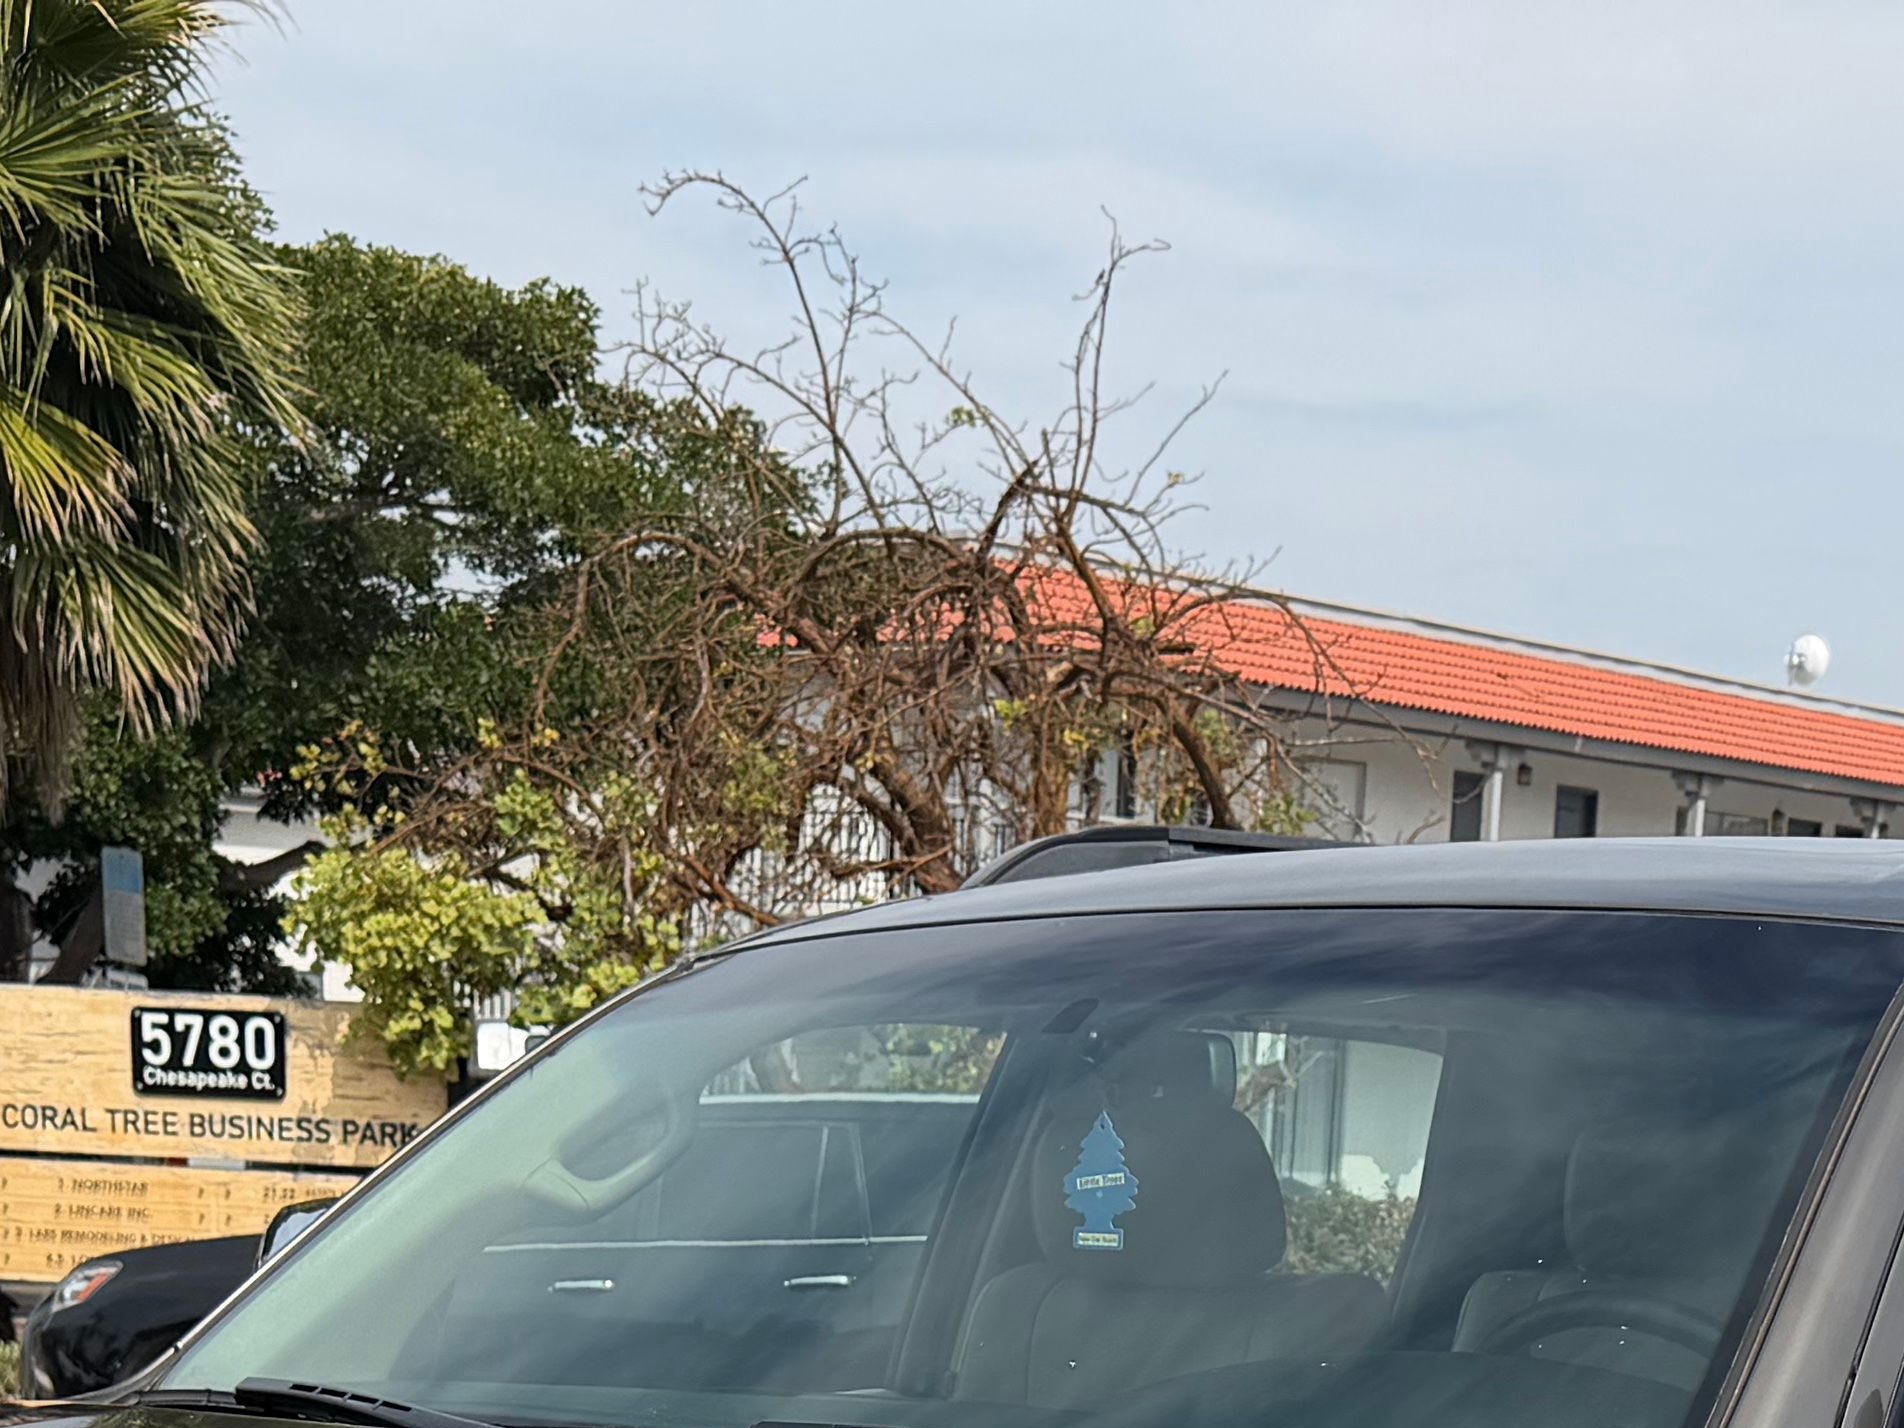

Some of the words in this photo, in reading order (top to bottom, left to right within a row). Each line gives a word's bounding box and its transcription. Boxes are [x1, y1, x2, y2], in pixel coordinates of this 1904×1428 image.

[141, 1012, 276, 1071] 5780
[143, 1066, 248, 1091] Chesapeake
[251, 1072, 275, 1091] Ct.
[2, 1103, 97, 1133] CORAL
[105, 1108, 178, 1137] TREE
[190, 1112, 332, 1144] BUSINESS
[342, 1119, 418, 1149] PARK
